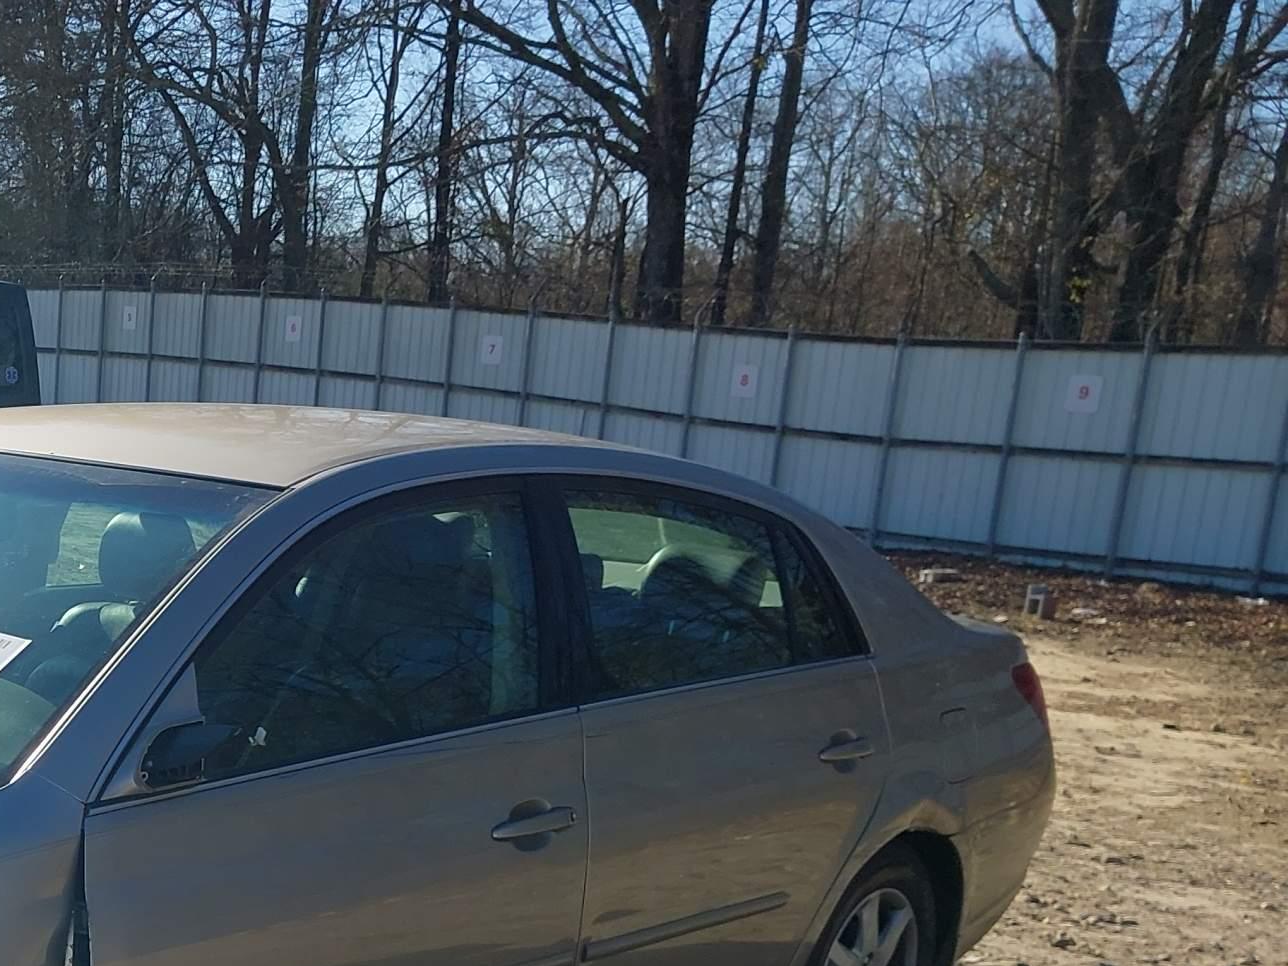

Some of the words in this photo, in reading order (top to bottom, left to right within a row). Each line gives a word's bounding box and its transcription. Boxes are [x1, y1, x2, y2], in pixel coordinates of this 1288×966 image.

[488, 344, 496, 355] 7
[740, 374, 749, 386] 8
[1079, 385, 1089, 400] 9
